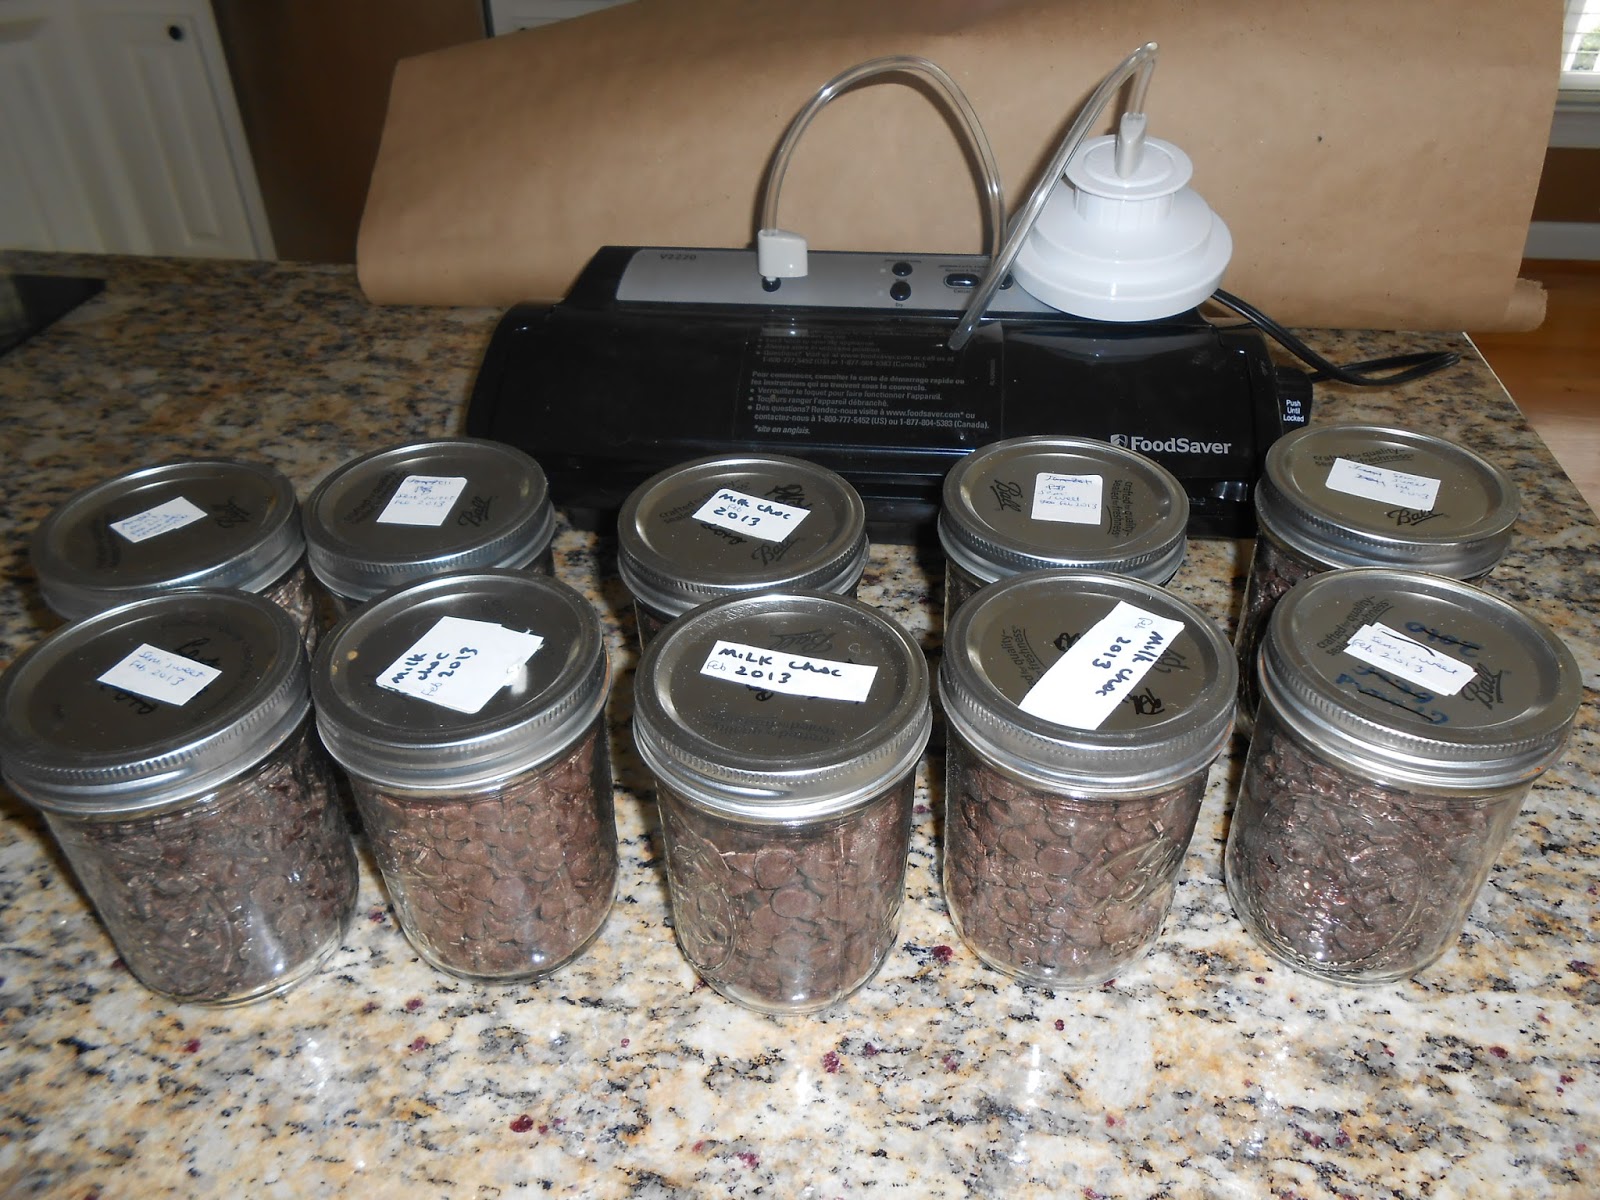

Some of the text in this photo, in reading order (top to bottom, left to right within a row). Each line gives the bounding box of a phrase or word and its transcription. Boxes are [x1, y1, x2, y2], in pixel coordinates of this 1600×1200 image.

[763, 379, 806, 387] instructions
[930, 377, 954, 385] rapide
[757, 387, 794, 395] Verrouiller
[804, 388, 826, 397] loquet
[864, 391, 905, 399] fonctionner
[788, 397, 812, 405] ranger
[755, 403, 770, 411] Des
[771, 404, 810, 412] questions?
[811, 406, 857, 414] Rendez-nous
[858, 407, 878, 415] visite
[1285, 399, 1301, 407] Push
[1286, 406, 1301, 415] Until
[754, 413, 810, 422] contactez-nous
[811, 414, 816, 422] à
[818, 415, 870, 424] 1-800-777-5452
[871, 417, 888, 425] (US)
[899, 418, 953, 427] 1-877-804-5383
[954, 420, 990, 430] (Canada).
[1283, 414, 1305, 423] Locked
[782, 426, 811, 435] anglais.
[1131, 436, 1232, 454] FoodSaver
[990, 478, 1025, 513] Ball
[457, 495, 493, 528] Ball
[713, 506, 761, 527] 2013
[1092, 636, 1131, 669] 2013
[438, 646, 479, 679] 2013
[151, 669, 186, 687] 2013
[705, 659, 792, 685] Feb 2013
[1460, 662, 1503, 711] Ball
